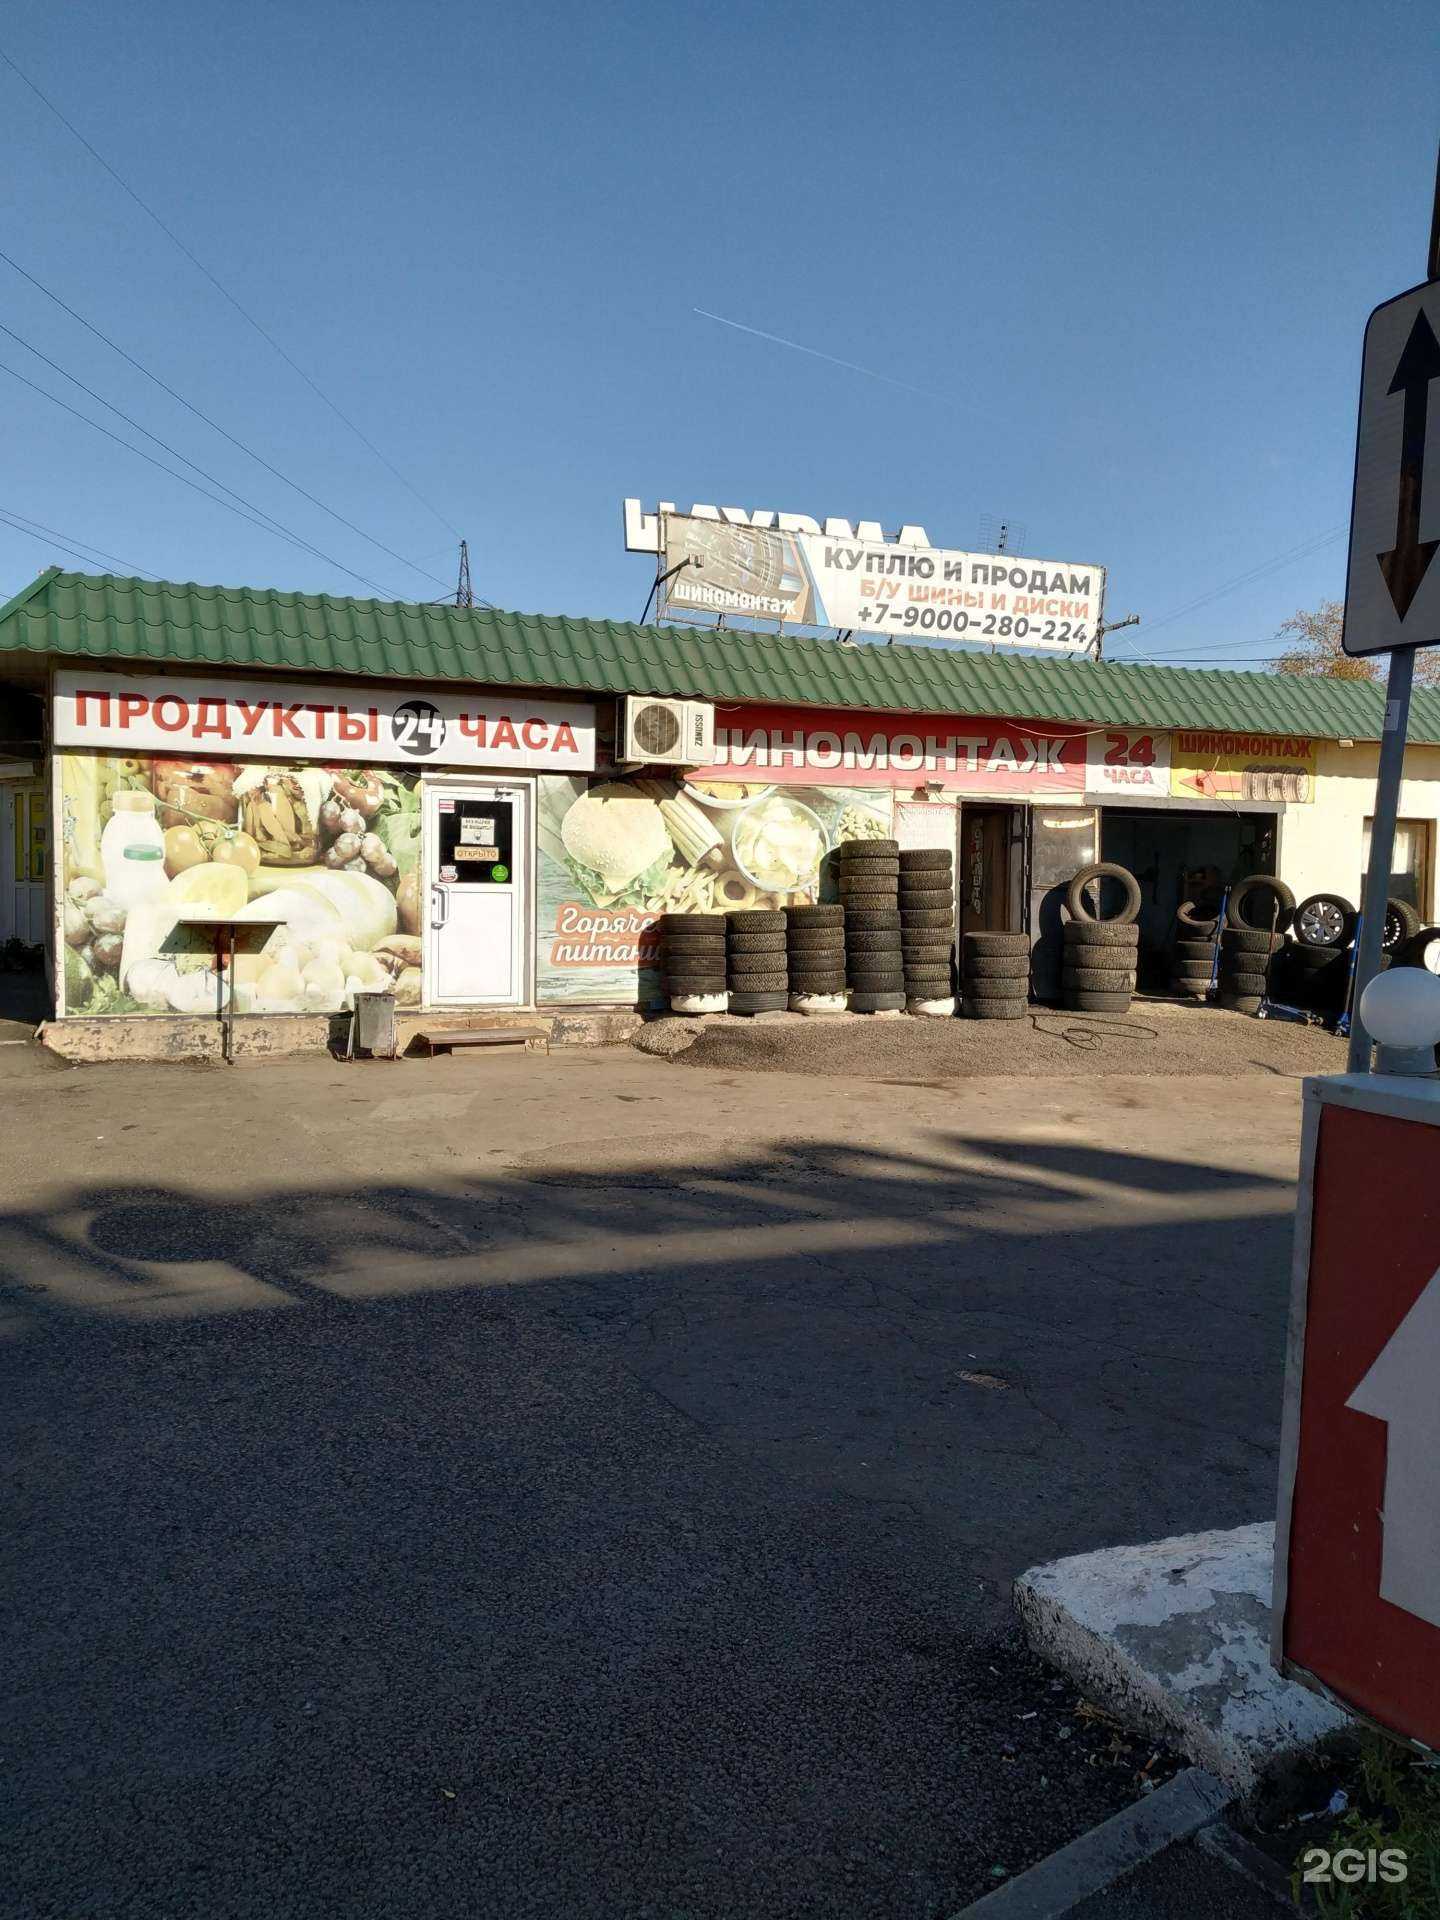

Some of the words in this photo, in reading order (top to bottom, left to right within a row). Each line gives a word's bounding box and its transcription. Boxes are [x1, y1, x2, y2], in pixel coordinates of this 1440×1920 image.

[824, 546, 935, 579] КУПЛЮ
[944, 560, 963, 582] И
[971, 563, 1091, 596] ПРОДАМ
[860, 578, 901, 600] Б/У
[908, 583, 984, 609] ШИНЫ
[991, 592, 1006, 611] И
[1012, 595, 1090, 621] ДИСКИ
[858, 602, 1088, 644] +7-9000-280-224
[75, 690, 379, 743] ПРОДУКТЫ
[394, 702, 444, 748] 24
[459, 713, 580, 754] ЧАСА
[694, 714, 704, 747] ZANUSSI
[1103, 733, 1157, 767] 24
[1178, 732, 1313, 759] ШИНОМОНТАЖ
[1103, 768, 1154, 785] ЧАСА
[457, 850, 497, 858] ОТКРЫТО
[561, 907, 663, 943] Горяче
[556, 943, 664, 962] питани
